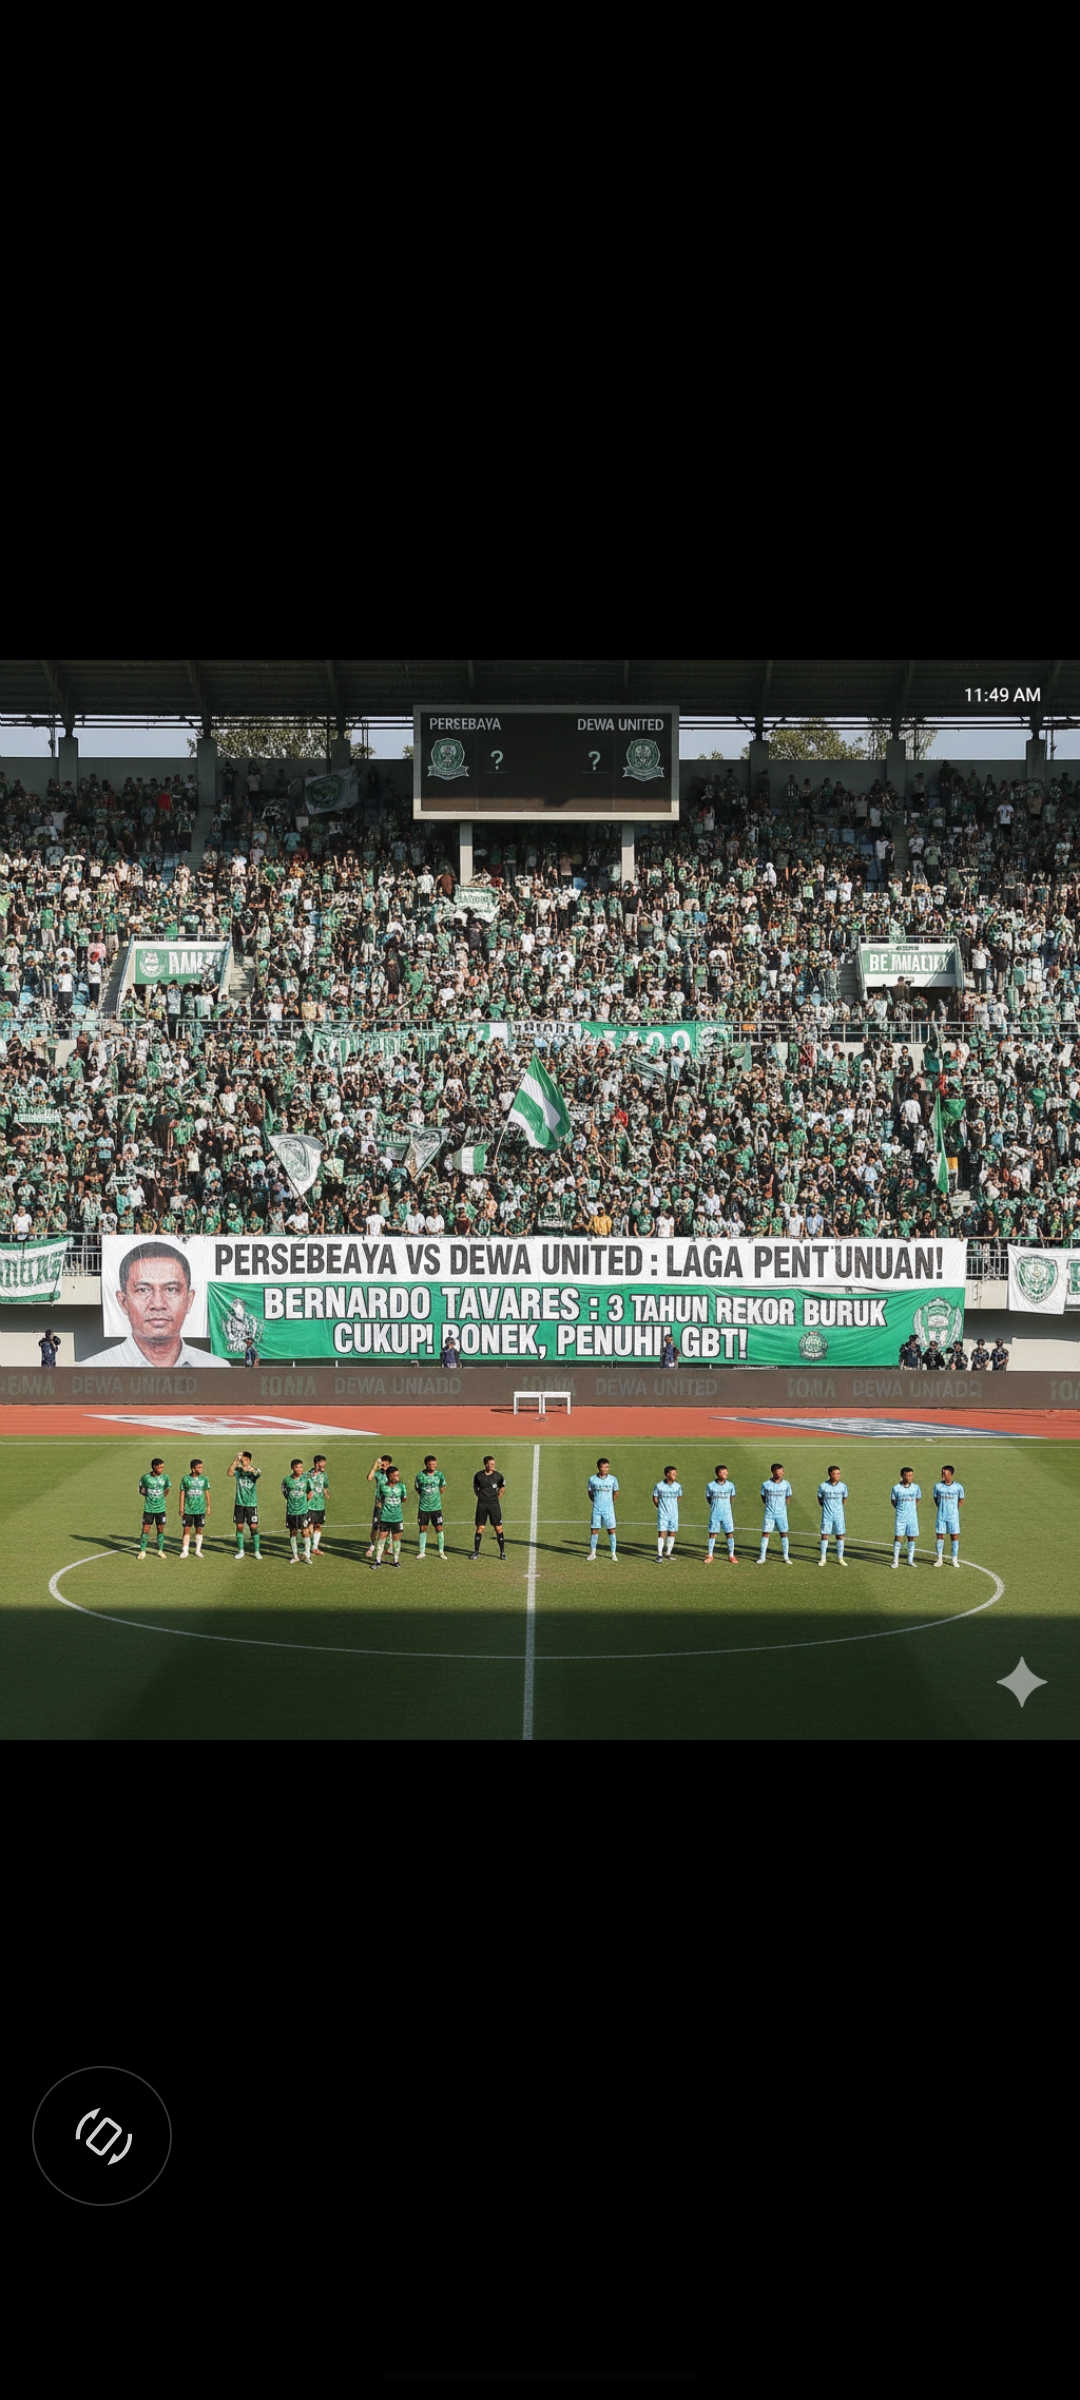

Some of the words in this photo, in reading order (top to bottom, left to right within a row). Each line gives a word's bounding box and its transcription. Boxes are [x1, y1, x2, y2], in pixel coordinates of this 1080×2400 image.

[429, 717, 502, 730] PERSEBAYA
[577, 718, 615, 731] DEWA
[618, 718, 665, 731] UNITED
[214, 1243, 397, 1276] PERSEBEAYA
[406, 1243, 441, 1276] VS
[450, 1244, 531, 1276] DEWA
[542, 1244, 643, 1276] UNITED
[666, 1245, 743, 1278] LAGA
[263, 1286, 431, 1320] BERNARDO
[441, 1286, 581, 1321] TAVARES
[607, 1293, 624, 1322] 3
[631, 1294, 708, 1323] TAHUN
[716, 1295, 796, 1326] REKOR
[803, 1298, 888, 1327] BURUK
[333, 1321, 434, 1354] CUKUP!
[681, 1326, 748, 1360] GBT!
[72, 1377, 122, 1395] DEWA
[335, 1377, 386, 1395] DEWA
[596, 1378, 647, 1396] DEWA
[654, 1379, 718, 1396] UNITED
[853, 1379, 904, 1398] DEWA
